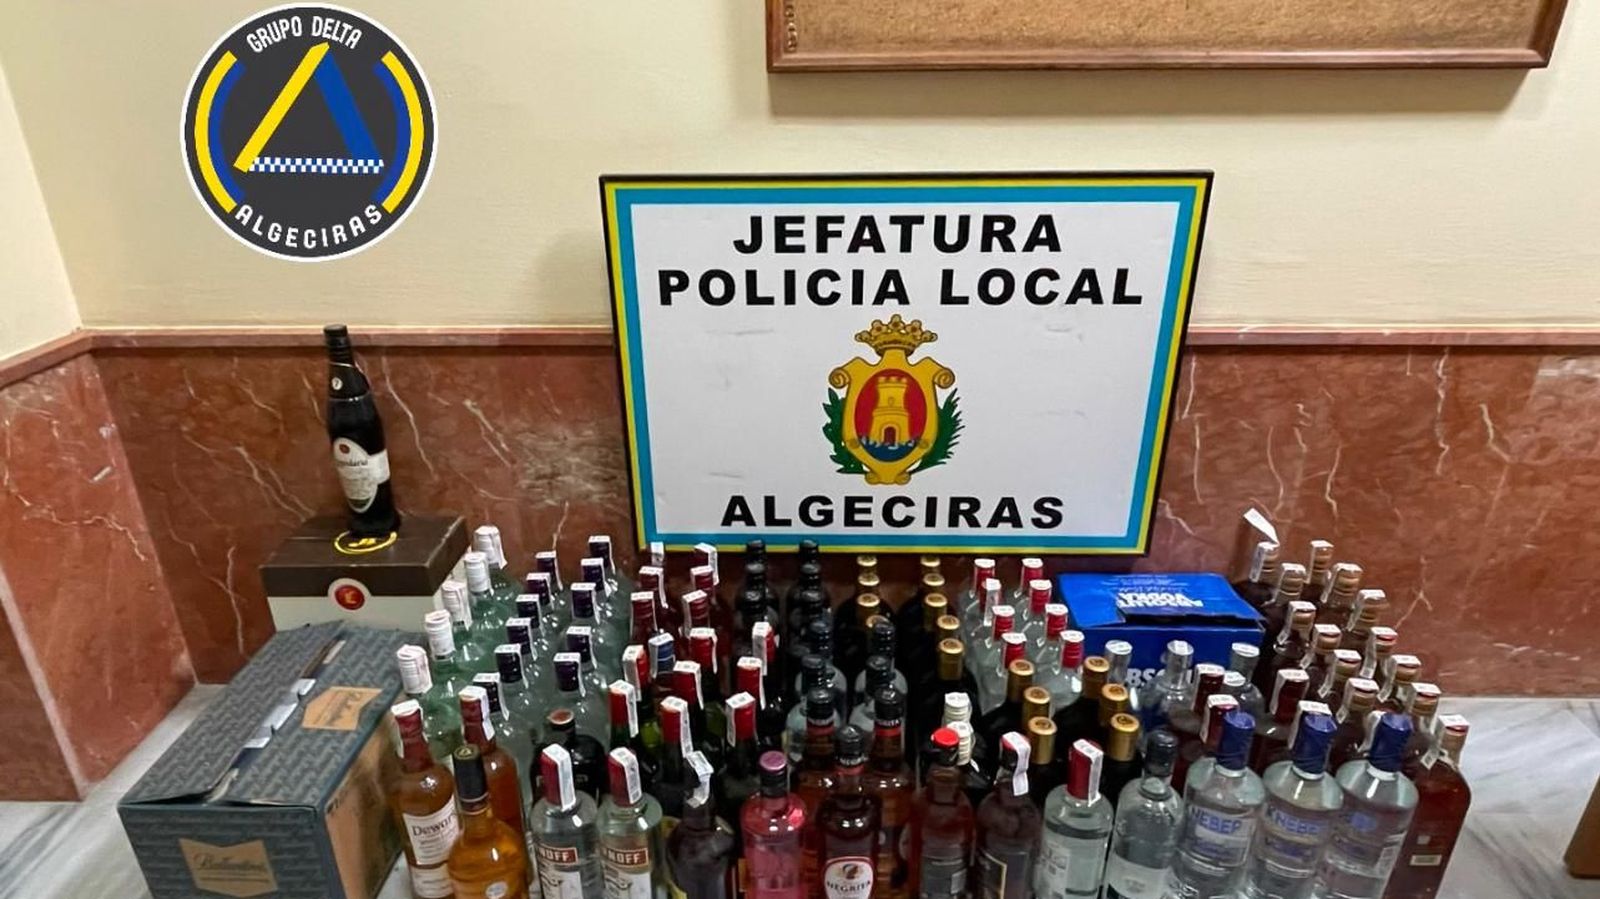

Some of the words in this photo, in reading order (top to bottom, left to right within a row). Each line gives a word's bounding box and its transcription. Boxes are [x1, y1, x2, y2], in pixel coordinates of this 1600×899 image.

[733, 214, 1062, 254] JEFATURA
[658, 269, 910, 306] POLICIA
[939, 267, 1143, 305] LOCAL
[720, 494, 1064, 529] ALGECIRAS
